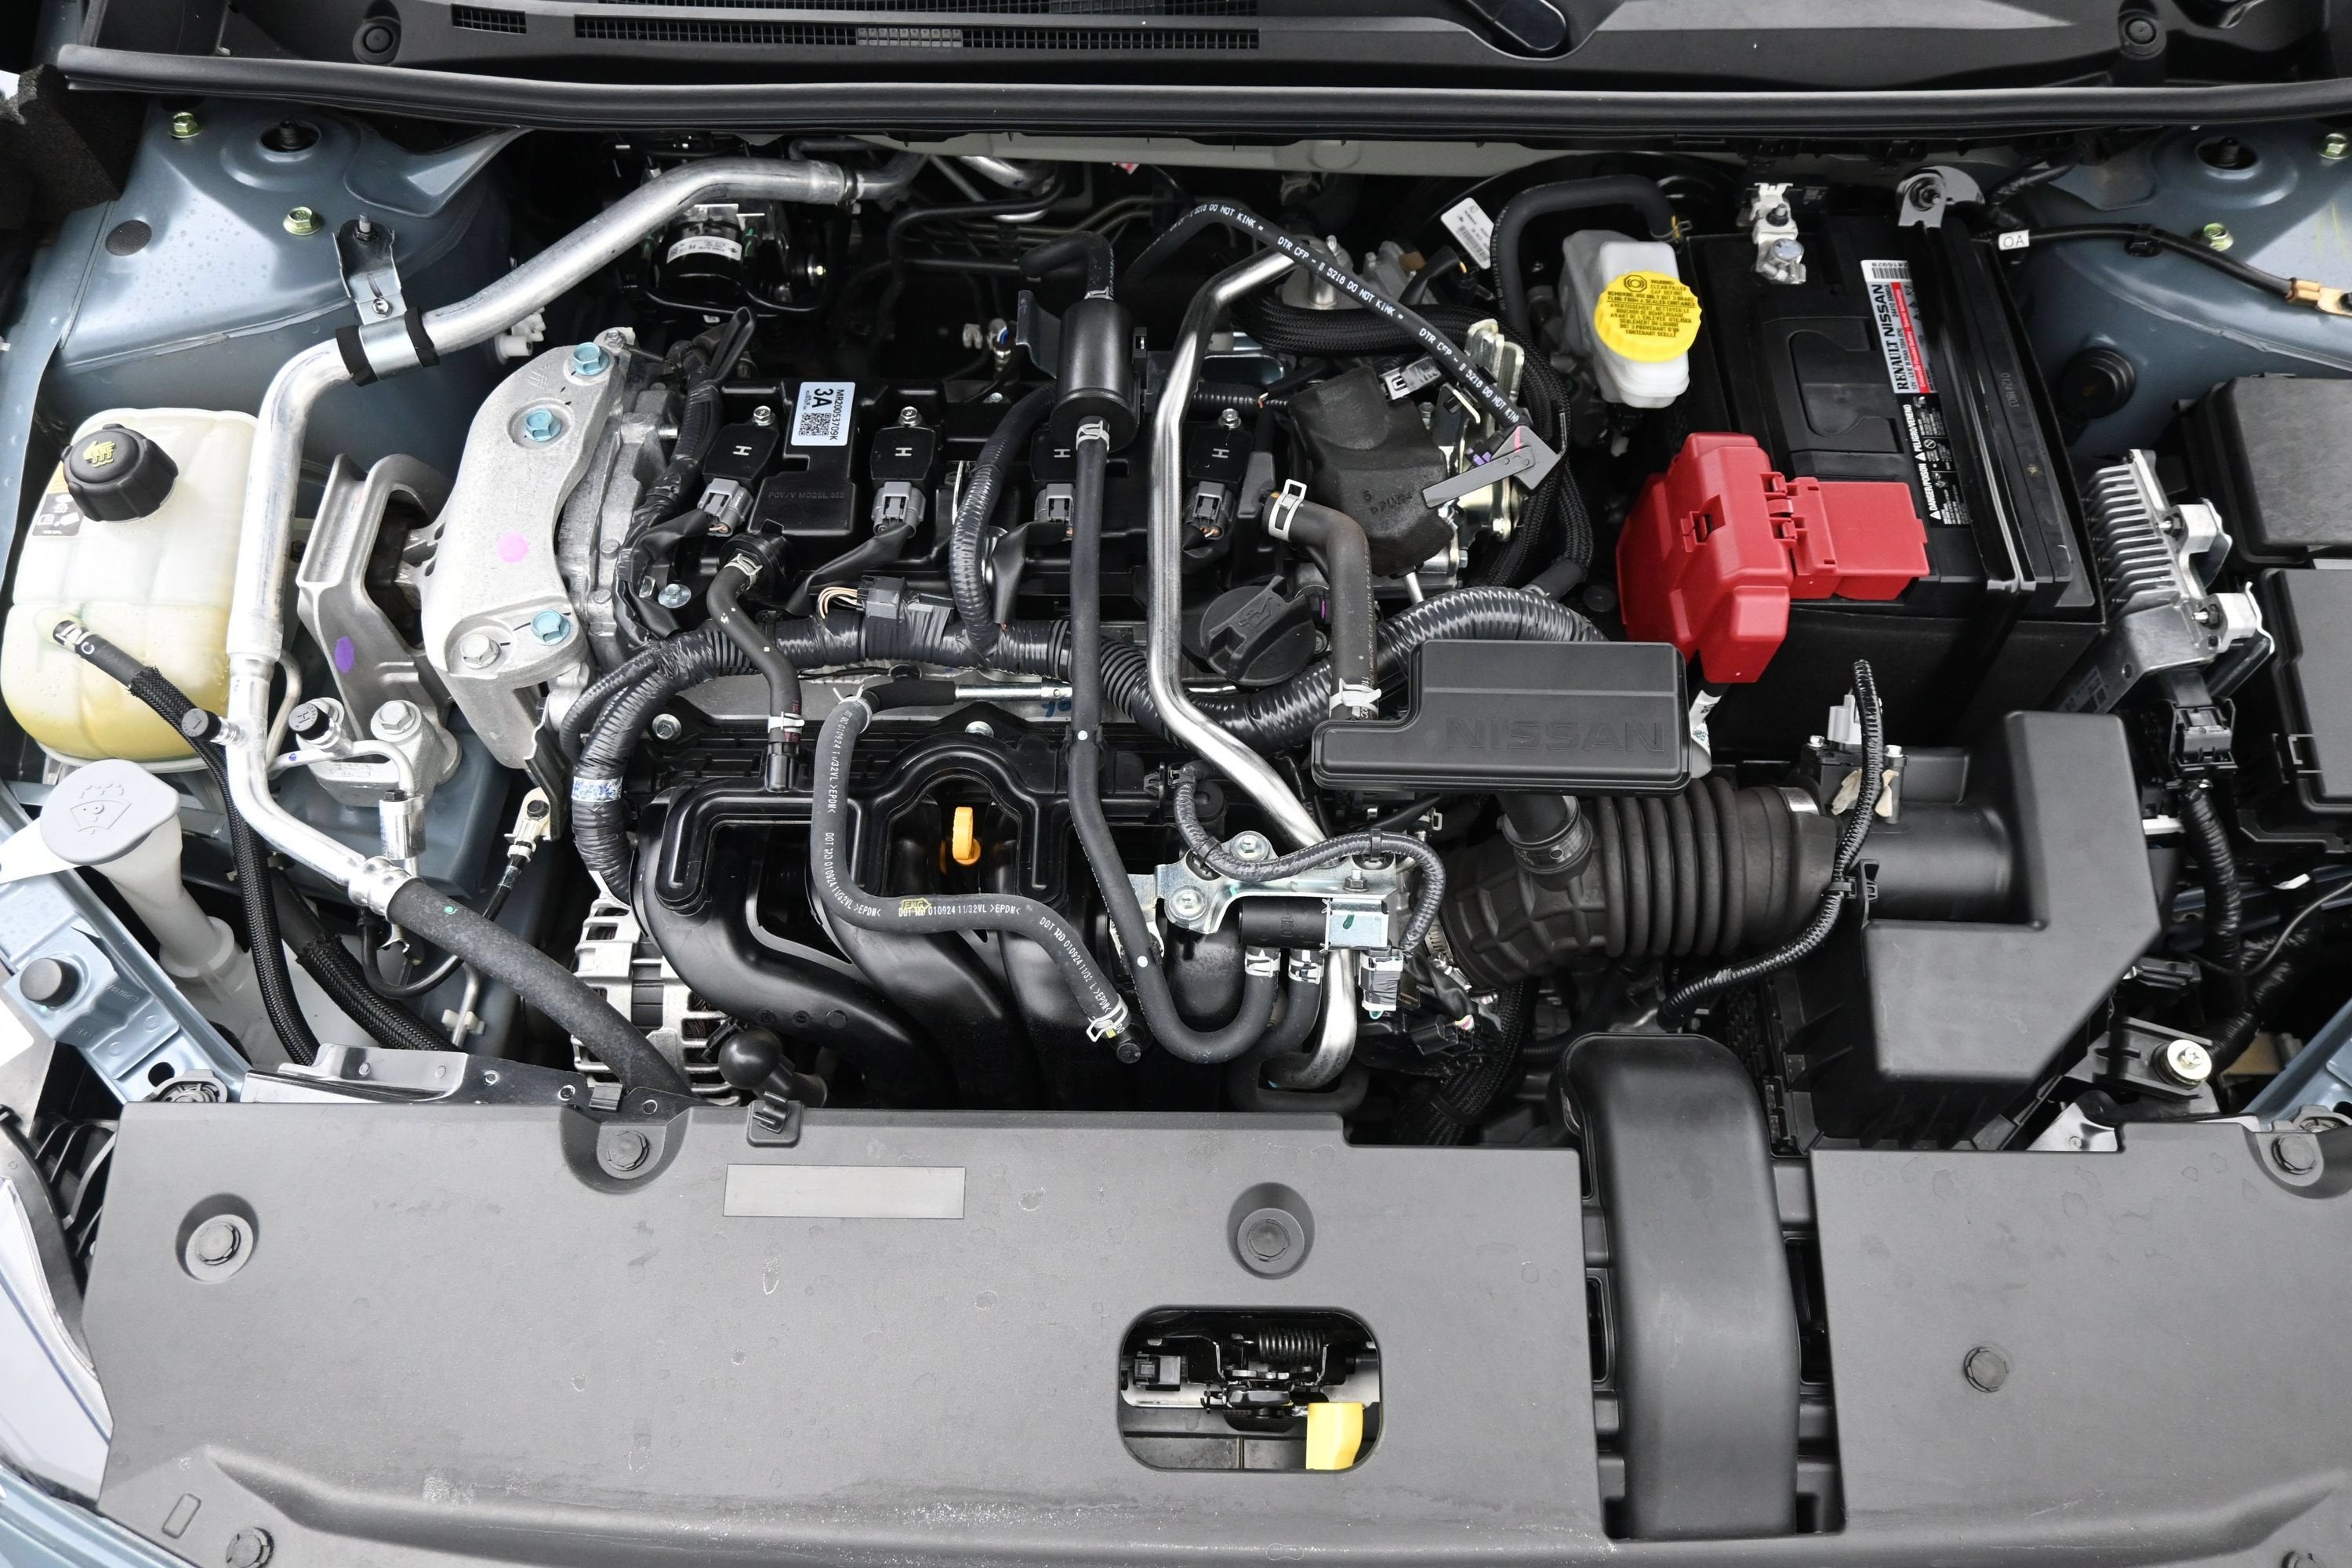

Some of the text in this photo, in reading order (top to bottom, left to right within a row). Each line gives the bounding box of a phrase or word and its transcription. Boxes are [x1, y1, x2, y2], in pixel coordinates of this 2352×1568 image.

[1220, 205, 1236, 216] NOT
[1236, 212, 1256, 228] KINK
[1278, 236, 1396, 317] DTR CFP 5218 DO NOT KINK
[1871, 284, 1909, 390] RENAULT NISSAN
[1419, 328, 1436, 343] DTR
[1436, 342, 1452, 355] CFP
[1465, 369, 1483, 388] 5218
[1482, 386, 1494, 397] DO
[1492, 395, 1506, 410] NOT
[812, 388, 834, 408] 3A
[829, 389, 844, 441] MR20053709K
[1903, 405, 1922, 452] PELIGRO/VENENO
[1918, 463, 1938, 510] DANGER/POISON
[1446, 720, 1666, 753] NISSAN
[825, 833, 834, 845] DOT
[928, 906, 956, 916] 010924
[1040, 916, 1055, 931] DOT
[1064, 940, 1083, 966] 010924
